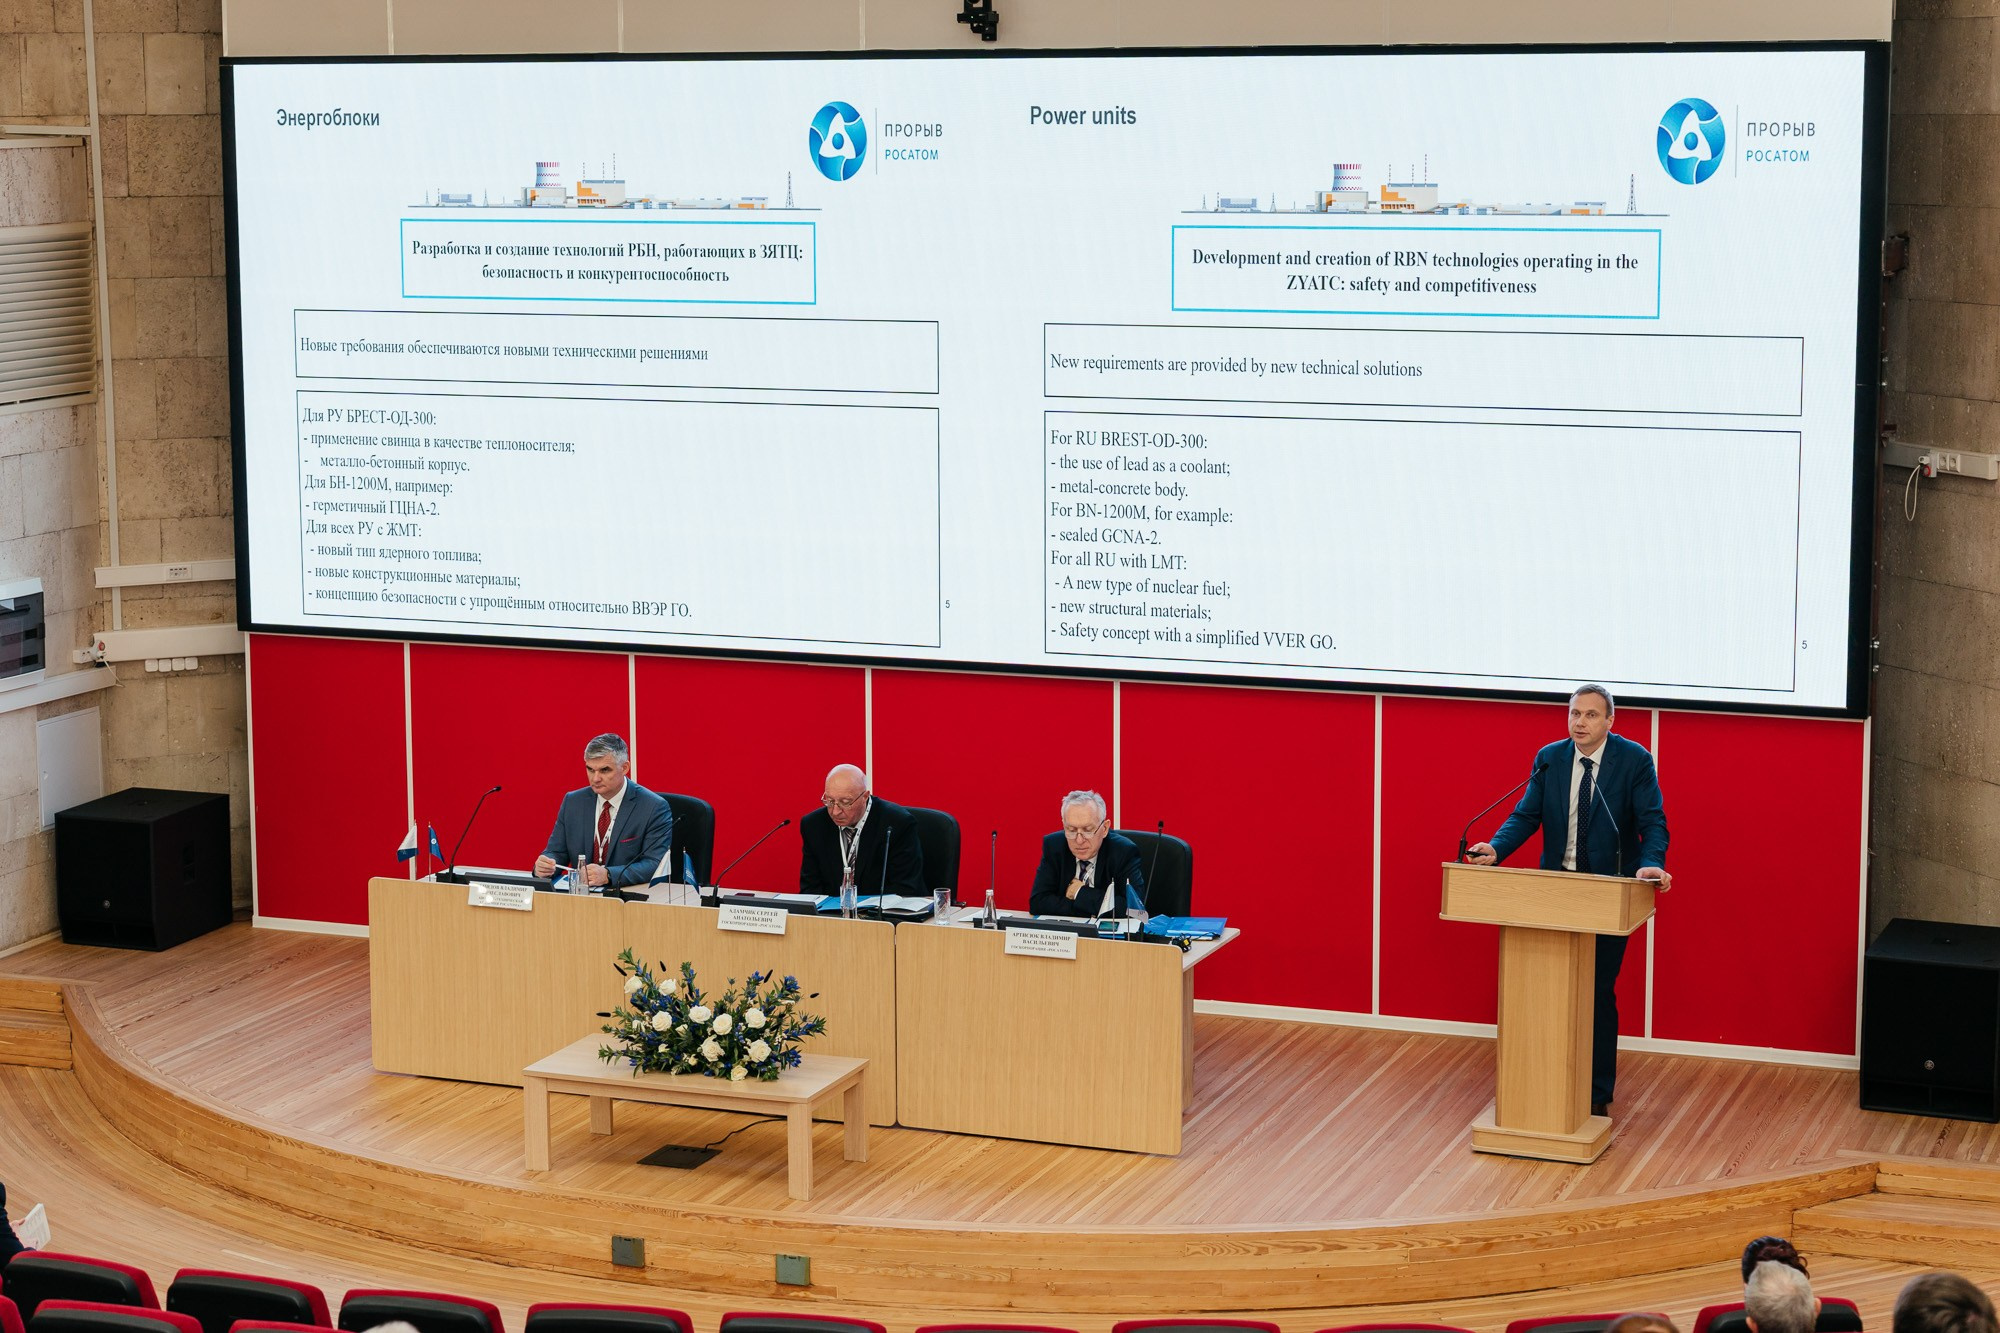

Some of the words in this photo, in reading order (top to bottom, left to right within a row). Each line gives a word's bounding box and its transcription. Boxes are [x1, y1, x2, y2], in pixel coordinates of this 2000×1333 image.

[276, 107, 379, 130] Энергоблоки
[1030, 105, 1086, 125] Power
[1092, 105, 1136, 125] units
[884, 123, 942, 137] ПРОРЫВ
[1747, 121, 1815, 137] ПРОРЫВ
[884, 148, 938, 161] РОСАТОМ
[1745, 149, 1809, 162] РОСАТОМ
[412, 240, 480, 258] Разработка
[484, 245, 491, 255] и
[495, 245, 549, 256] создание
[552, 243, 624, 257] технологий
[628, 242, 660, 260] РБН,
[663, 243, 745, 261] работающих
[748, 248, 756, 258] в
[760, 244, 802, 261] ЗЯТЦ:
[1192, 248, 1281, 269] Development
[1285, 250, 1311, 265] and
[1315, 250, 1371, 266] creation
[1375, 250, 1391, 266] of
[1393, 251, 1427, 266] RBN
[1432, 251, 1518, 272] technologies
[1523, 253, 1592, 273] operating
[1597, 253, 1610, 269] in
[1615, 253, 1638, 269] the
[482, 264, 563, 279] безопасность
[566, 269, 574, 279] и
[577, 266, 729, 284] конкурентоспособность
[1286, 274, 1344, 290] ZYATC:
[1349, 275, 1390, 295] safety
[1394, 276, 1420, 292] and
[1425, 277, 1536, 297] competitiveness
[300, 337, 337, 351] Новые
[339, 338, 404, 356] требования
[407, 339, 500, 355] обеспечиваются
[503, 345, 549, 357] новыми
[552, 346, 636, 359] техническими
[639, 348, 708, 363] решениями
[1050, 353, 1079, 368] New
[1083, 354, 1164, 373] requirements
[1167, 360, 1187, 371] are
[1190, 356, 1246, 376] provided
[1250, 357, 1267, 377] by
[1270, 362, 1297, 373] new
[1301, 358, 1359, 375] technical
[1363, 359, 1422, 377] solutions
[302, 407, 324, 424] Для
[327, 408, 343, 422] РУ
[347, 409, 436, 427] БРЕСТ-ОД-300:
[310, 434, 378, 448] применение
[380, 436, 421, 448] свинца
[423, 437, 430, 448] в
[433, 437, 482, 449] качестве
[484, 439, 575, 454] теплоносителя;
[1050, 429, 1072, 445] For
[1075, 430, 1096, 446] RU
[1101, 431, 1207, 449] BREST-OD-300:
[320, 454, 424, 470] металло-бетонный
[427, 460, 470, 475] корпус.
[1059, 453, 1078, 469] the
[1082, 459, 1102, 470] use
[1106, 455, 1121, 470] of
[1123, 455, 1148, 472] lead
[1152, 461, 1165, 472] as
[1169, 461, 1176, 473] a
[1180, 458, 1230, 477] coolant;
[304, 474, 326, 490] Для
[329, 475, 391, 493] БН-1200М,
[394, 481, 452, 497] например:
[1059, 478, 1150, 496] metal-concrete
[1154, 480, 1188, 501] body.
[312, 499, 386, 515] герметичный
[389, 499, 439, 517] ГЦНА-2.
[1051, 501, 1072, 517] For
[1076, 502, 1150, 523] BN-1200M,
[1154, 504, 1173, 521] for
[1175, 507, 1232, 526] example:
[305, 518, 327, 535] Для
[330, 523, 354, 534] всех
[358, 520, 374, 535] РУ
[377, 525, 383, 535] с
[386, 522, 421, 537] ЖМТ:
[1059, 526, 1097, 542] sealed
[1101, 527, 1161, 545] GCNA-2.
[317, 542, 352, 556] новый
[355, 546, 375, 558] тип
[378, 548, 429, 563] ядерного
[432, 550, 481, 565] топлива;
[1051, 549, 1072, 565] For
[1075, 550, 1090, 566] all
[1094, 551, 1116, 567] RU
[1119, 552, 1147, 569] with
[1151, 554, 1186, 570] LMT:
[315, 567, 349, 578] новые
[352, 568, 452, 584] конструкционные
[455, 573, 520, 589] материалы;
[1062, 574, 1074, 589] A
[1076, 579, 1102, 590] new
[1105, 578, 1132, 596] type
[1135, 577, 1151, 592] of
[1152, 578, 1199, 595] nuclear
[1202, 579, 1230, 599] fuel;
[315, 589, 378, 602] концепцию
[381, 588, 457, 606] безопасности
[460, 596, 466, 606] с
[469, 595, 545, 611] упрощённым
[548, 600, 628, 614] относительно
[632, 600, 667, 616] ВВЭР
[671, 602, 691, 617] ГО.
[945, 599, 950, 608] 5
[1059, 602, 1085, 613] new
[1088, 601, 1146, 617] structural
[1150, 603, 1211, 622] materials;
[1060, 621, 1098, 642] Safety
[1102, 628, 1150, 645] concept
[1153, 626, 1181, 642] with
[1185, 632, 1192, 643] a
[1195, 628, 1259, 649] simplified
[1263, 631, 1306, 648] VVER
[1309, 633, 1336, 650] GO.
[1801, 639, 1807, 649] 5
